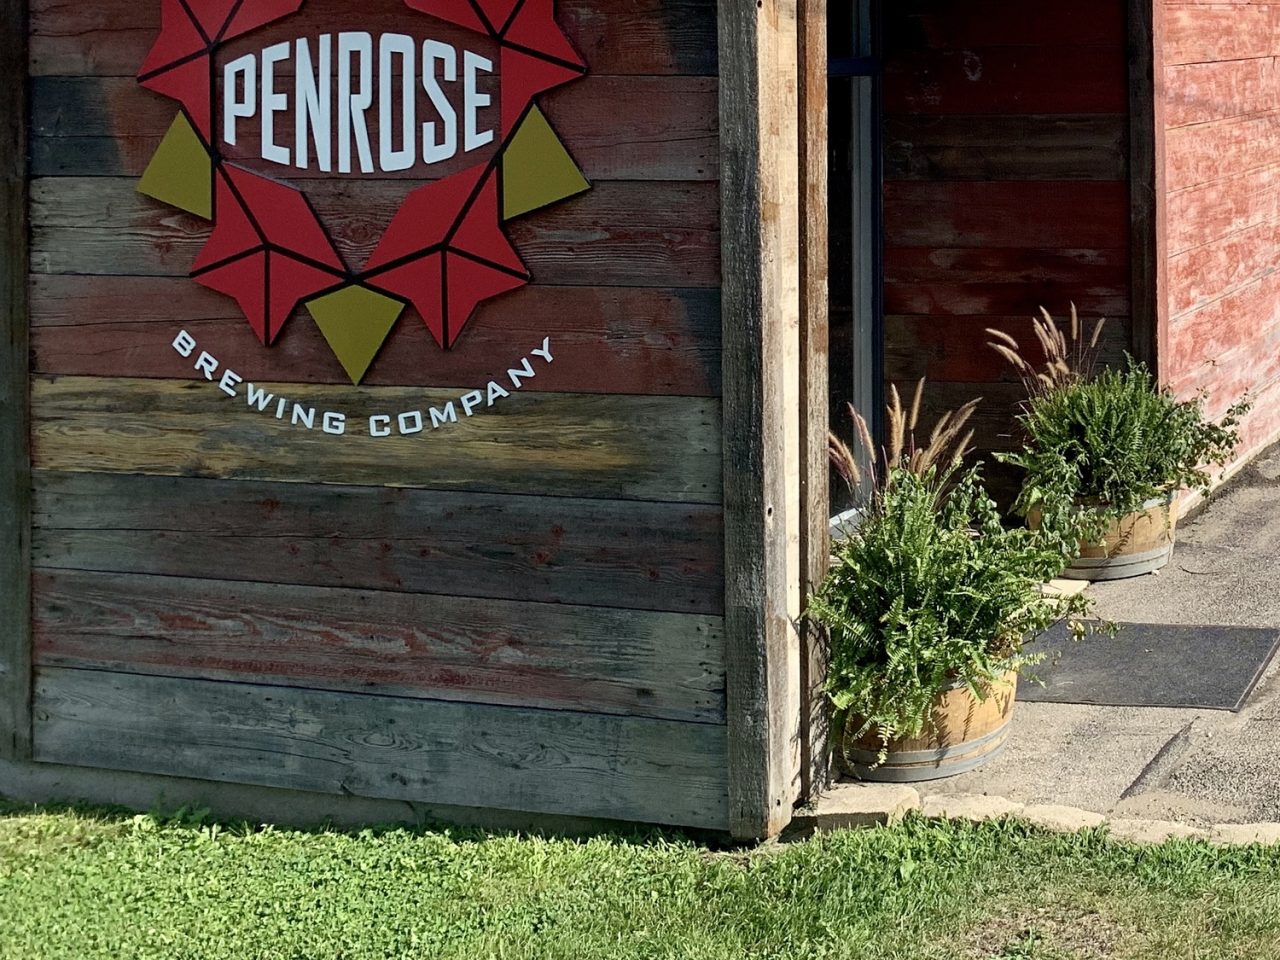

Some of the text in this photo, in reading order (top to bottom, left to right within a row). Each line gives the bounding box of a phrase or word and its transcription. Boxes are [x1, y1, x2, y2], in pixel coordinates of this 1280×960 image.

[223, 31, 494, 174] PENROSE
[171, 329, 555, 438] BREWING COMPANY
